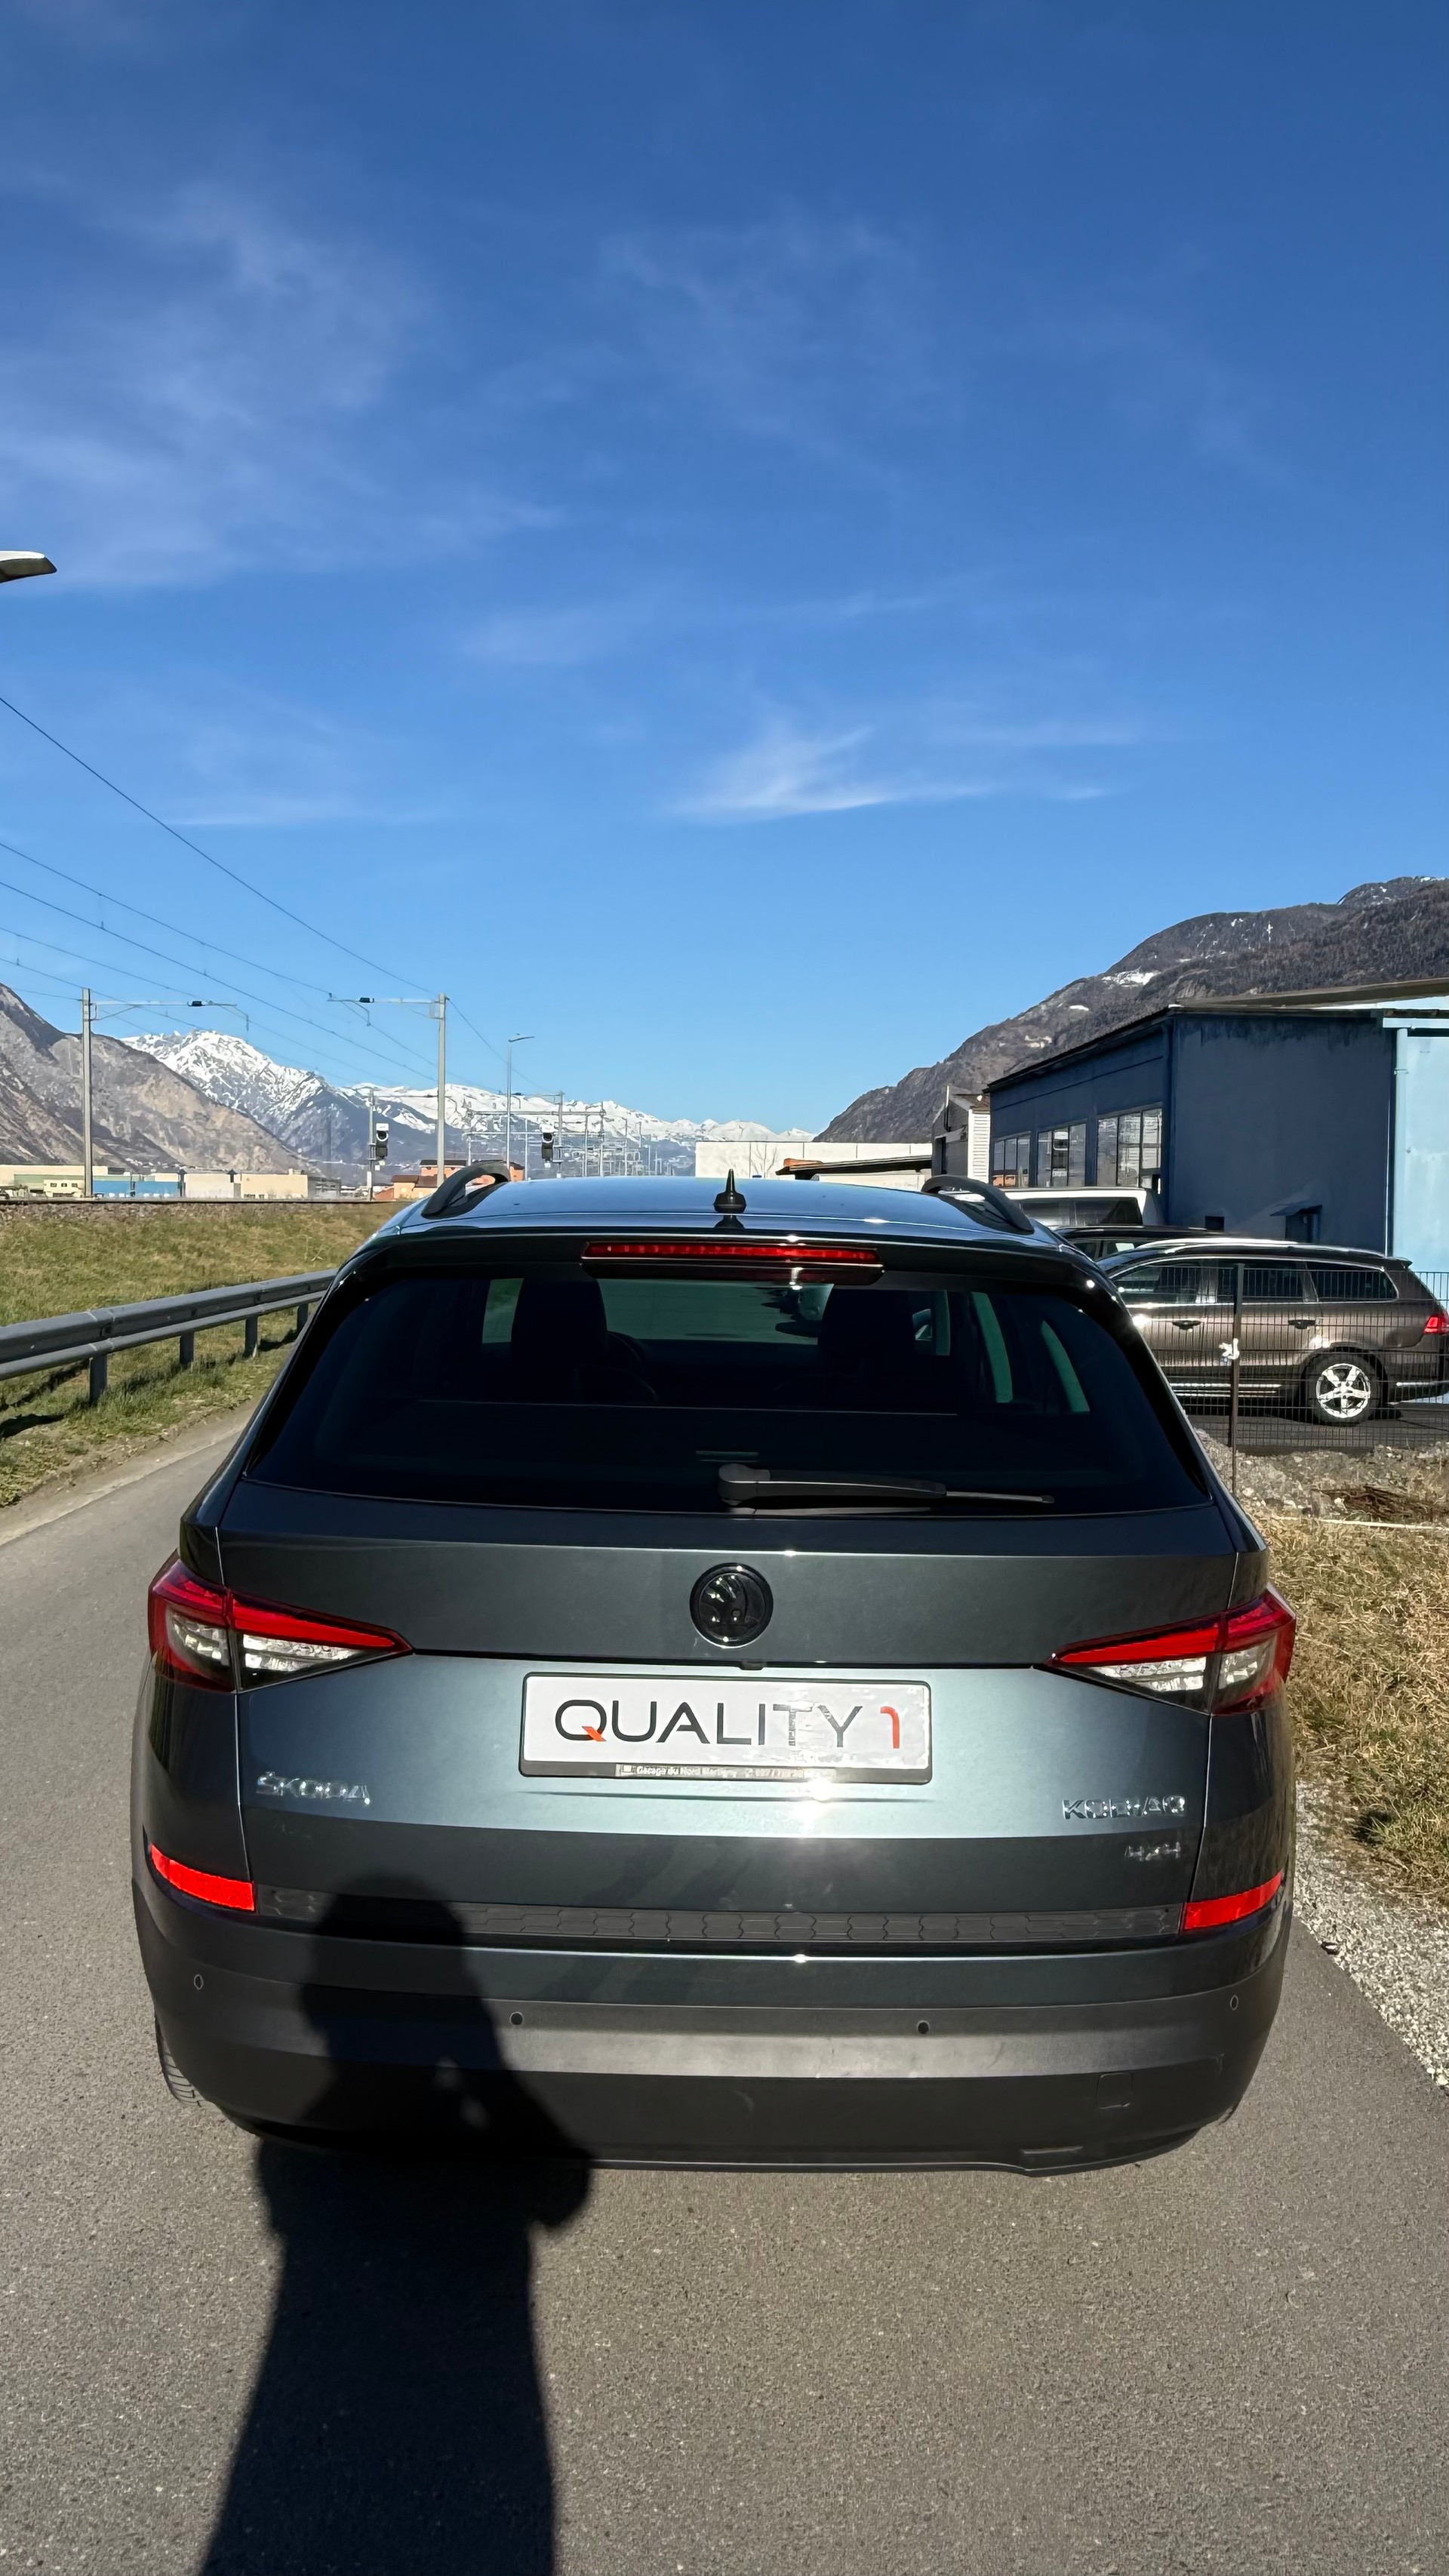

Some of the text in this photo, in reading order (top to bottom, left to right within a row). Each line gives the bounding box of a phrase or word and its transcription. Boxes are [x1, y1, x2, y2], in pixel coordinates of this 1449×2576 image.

[555, 1699, 900, 1749] QUALITY 1
[1062, 1796, 1186, 1820] KODIAQ
